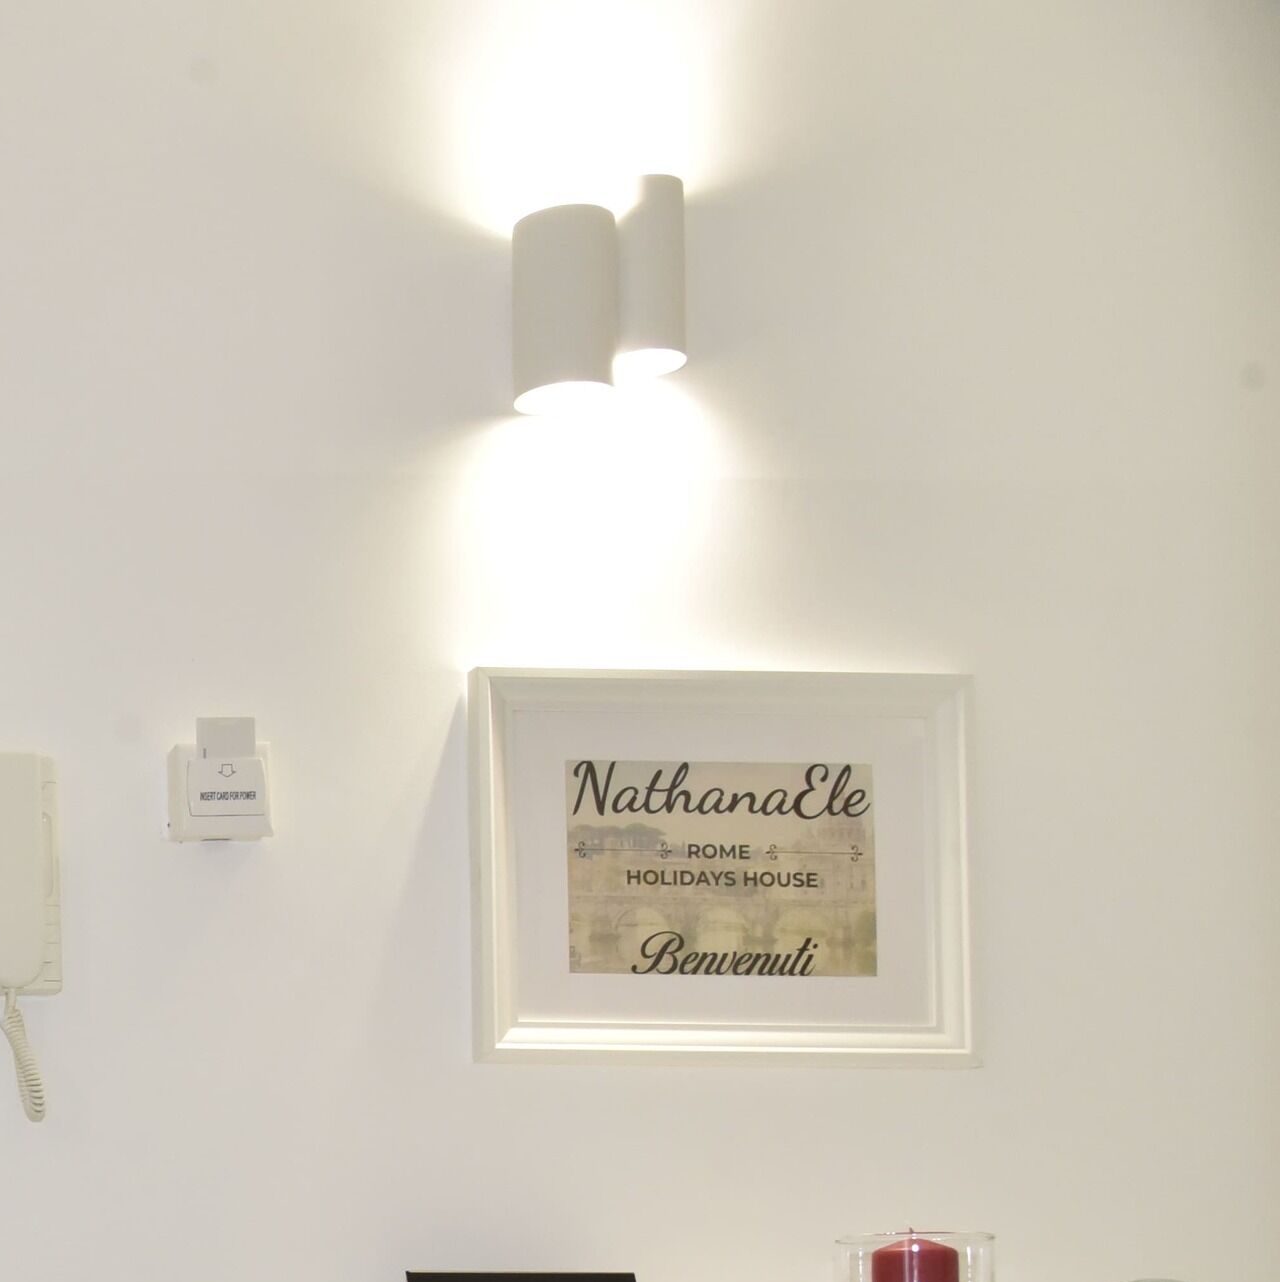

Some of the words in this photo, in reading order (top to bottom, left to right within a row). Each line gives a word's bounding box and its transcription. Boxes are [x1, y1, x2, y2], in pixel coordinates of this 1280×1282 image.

[199, 791, 216, 801] INSERT
[217, 791, 229, 801] CARD
[230, 791, 239, 801] FOR
[240, 790, 257, 801] POWER
[571, 759, 871, 820] NathanaEle
[686, 843, 752, 862] ROME
[625, 868, 737, 888] HOLIDAYS
[742, 870, 819, 889] HOUSE
[630, 930, 819, 977] Benvenuti
